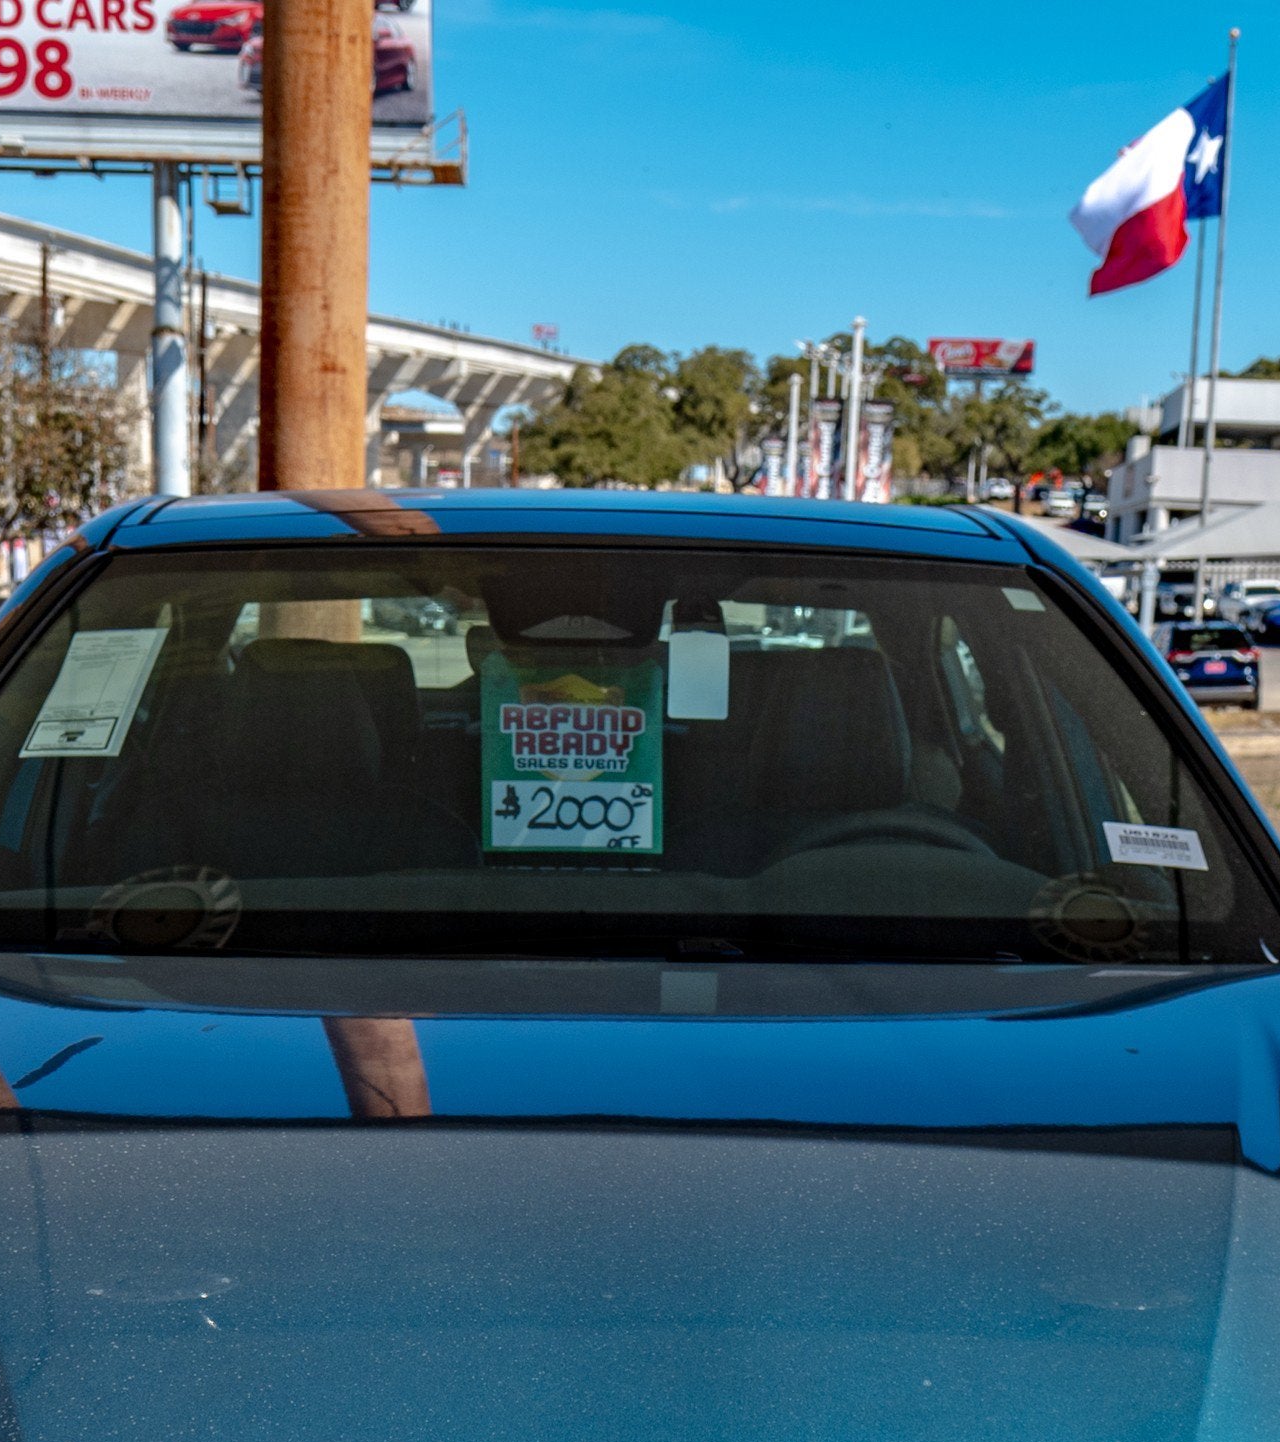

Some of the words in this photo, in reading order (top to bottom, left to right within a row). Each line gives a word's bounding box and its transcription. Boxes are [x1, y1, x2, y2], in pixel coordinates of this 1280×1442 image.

[35, 0, 156, 32] CARS
[503, 706, 643, 732] REFUND
[515, 732, 631, 757] READY
[517, 757, 568, 769] SALES
[574, 757, 627, 770] EVENT
[607, 835, 641, 849] OFF
